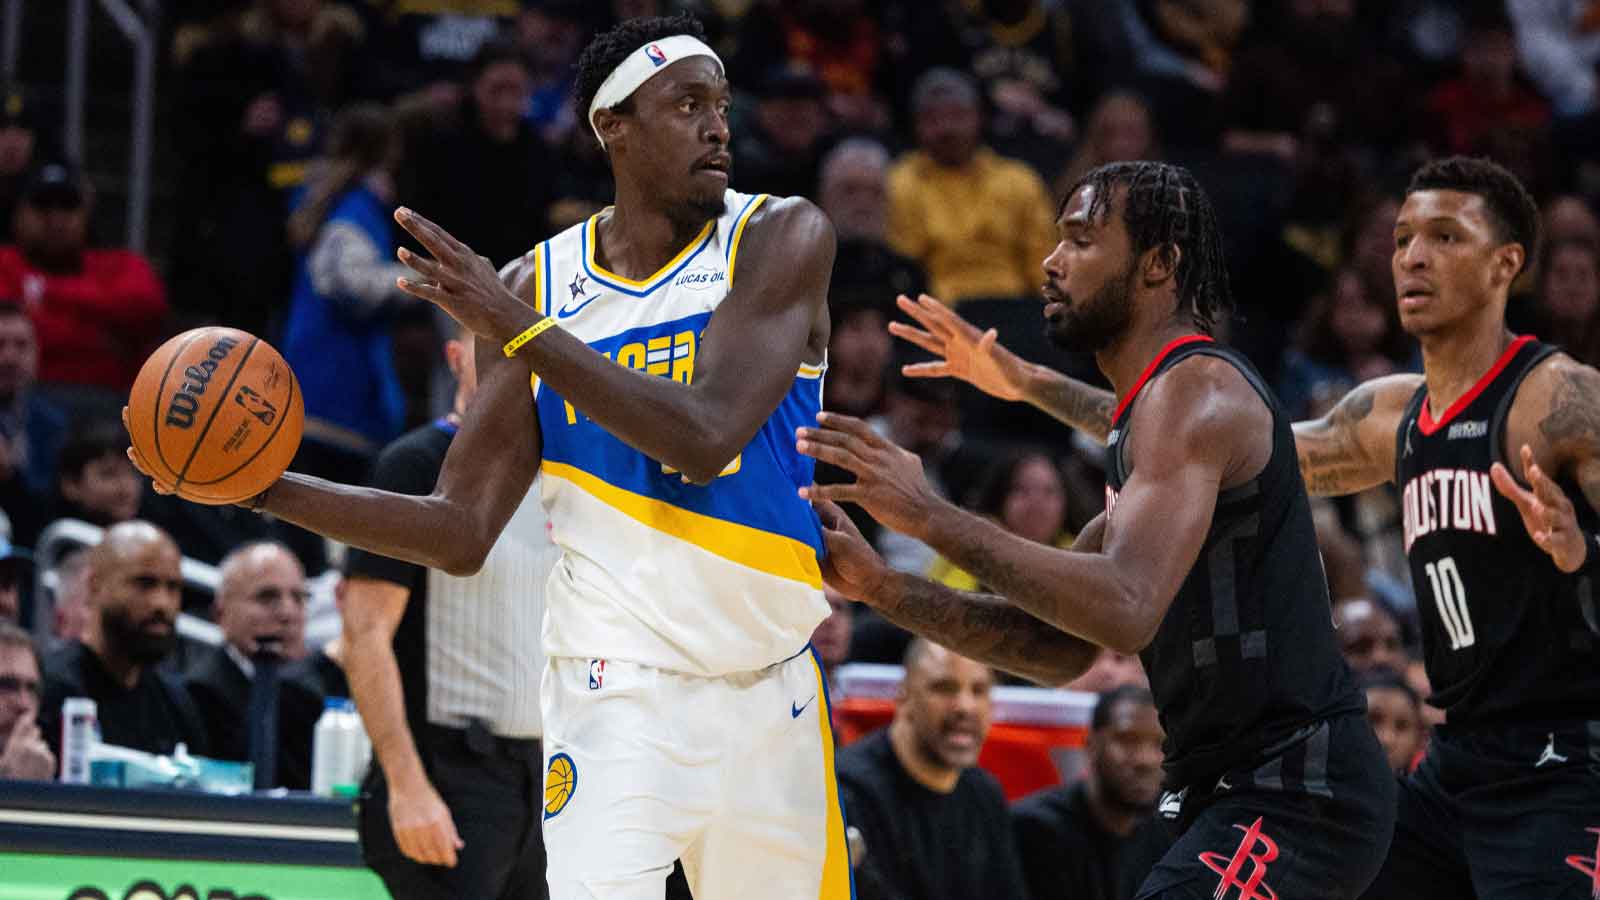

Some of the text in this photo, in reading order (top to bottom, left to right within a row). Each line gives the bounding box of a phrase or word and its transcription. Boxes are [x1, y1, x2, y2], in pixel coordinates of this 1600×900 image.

[675, 271, 725, 286] LUCAS OIL
[165, 336, 239, 430] Wilson
[1402, 468, 1497, 557] OUSTON
[1424, 555, 1476, 651] 10
